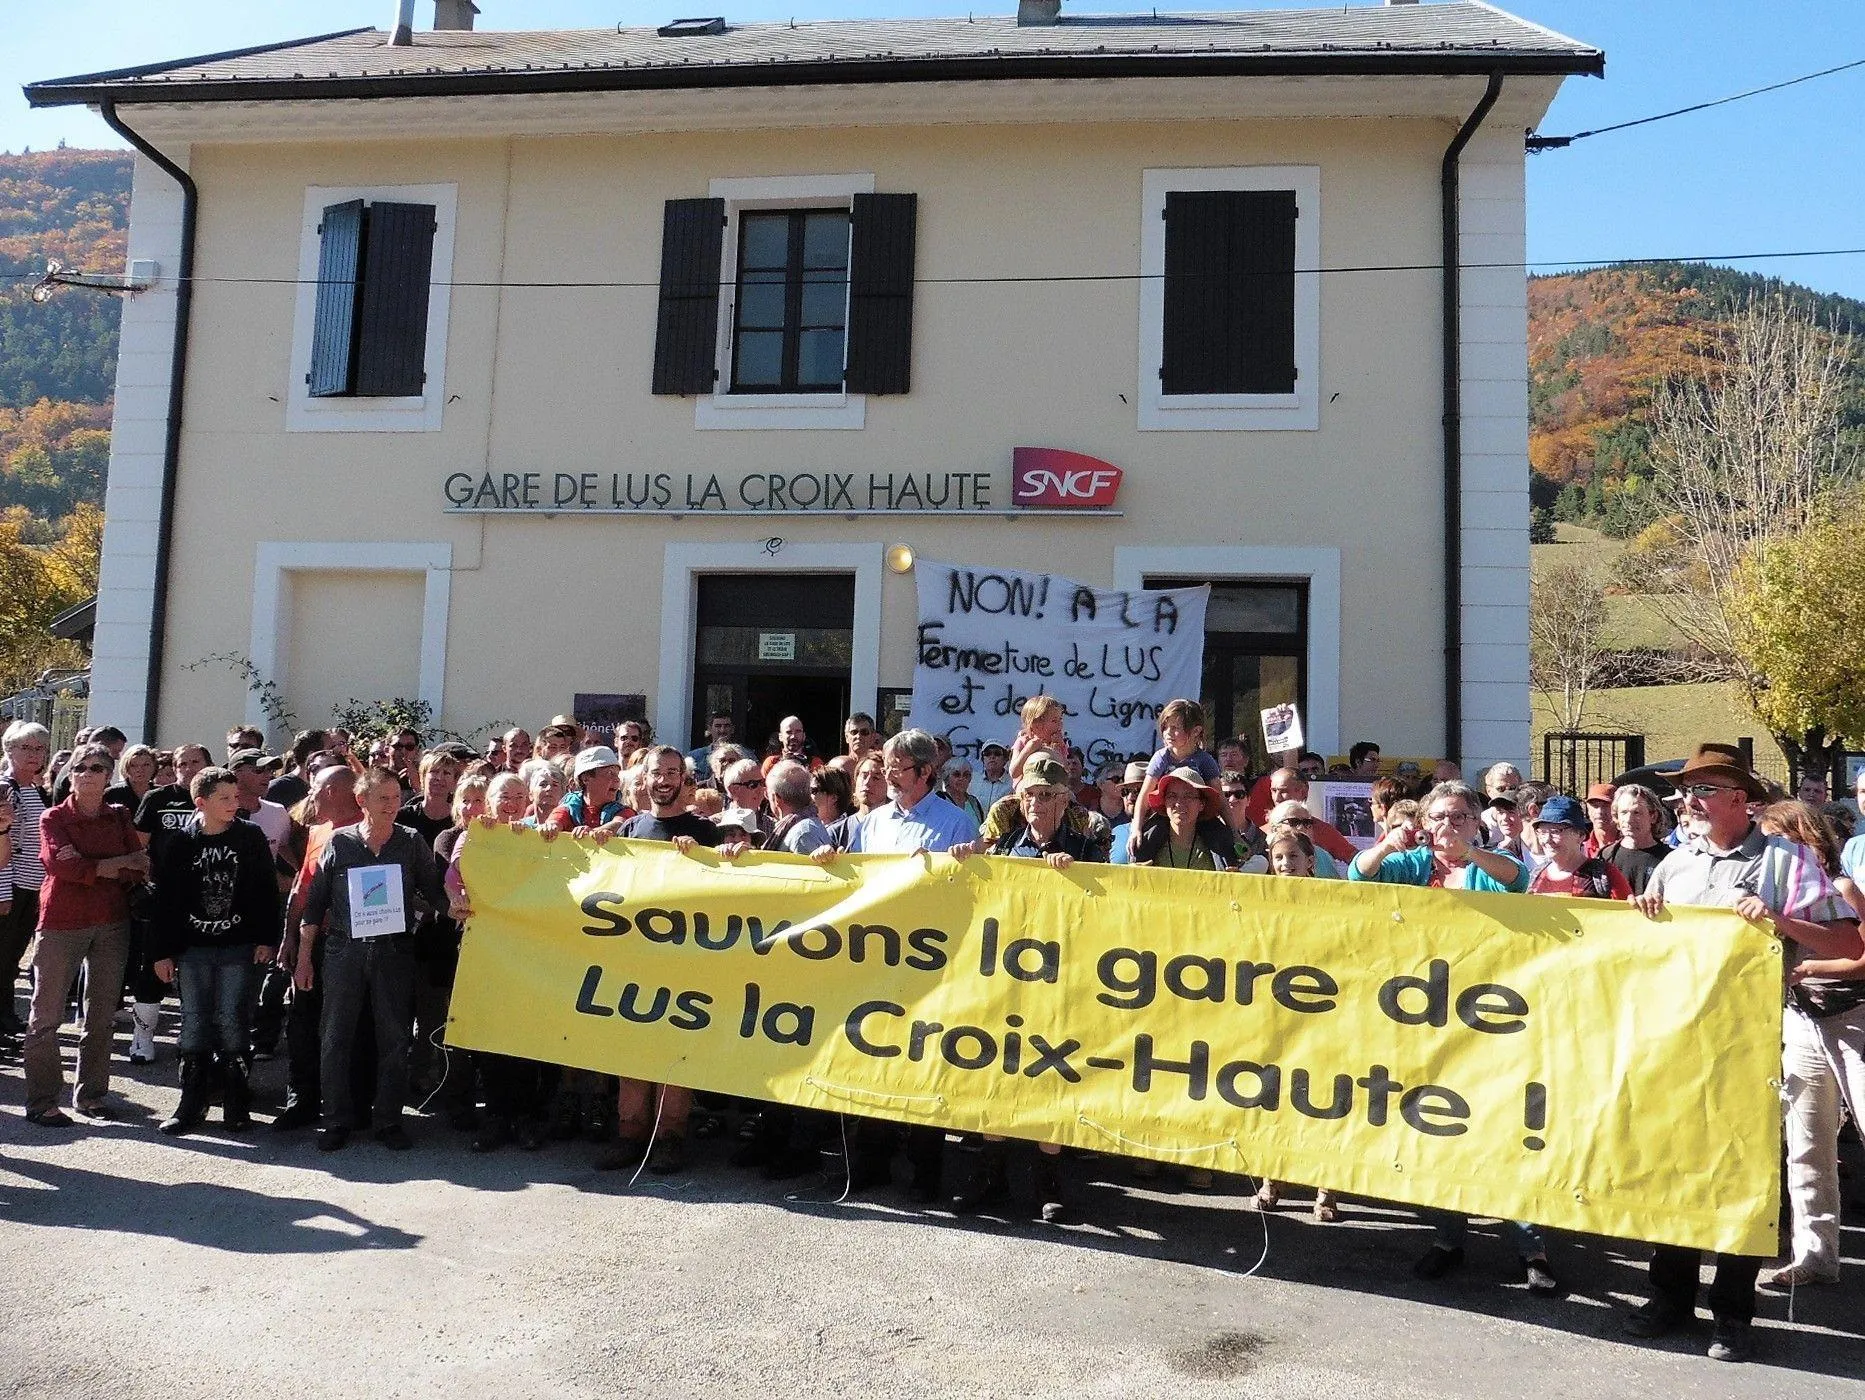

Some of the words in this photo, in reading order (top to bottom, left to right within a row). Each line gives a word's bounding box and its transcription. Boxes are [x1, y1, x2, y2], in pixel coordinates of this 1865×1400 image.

[444, 473, 540, 508] GARE
[554, 473, 598, 508] DE
[612, 473, 672, 508] LUS
[686, 473, 728, 509] LA
[739, 473, 854, 509] CROIX
[868, 472, 991, 509] HAUTE
[1018, 469, 1117, 498] SNCF
[918, 621, 1054, 677] Fermeture
[1063, 643, 1094, 679] de
[1101, 644, 1162, 681] LUS
[940, 676, 985, 715] et
[580, 891, 949, 972] Sauvons
[979, 917, 1061, 985] la
[1096, 946, 1339, 1014] gare
[1377, 958, 1530, 1034] de
[574, 964, 714, 1031] Lus
[739, 982, 815, 1046] la
[844, 1000, 1471, 1137] Croix-Haute
[1522, 1081, 1548, 1151] !
